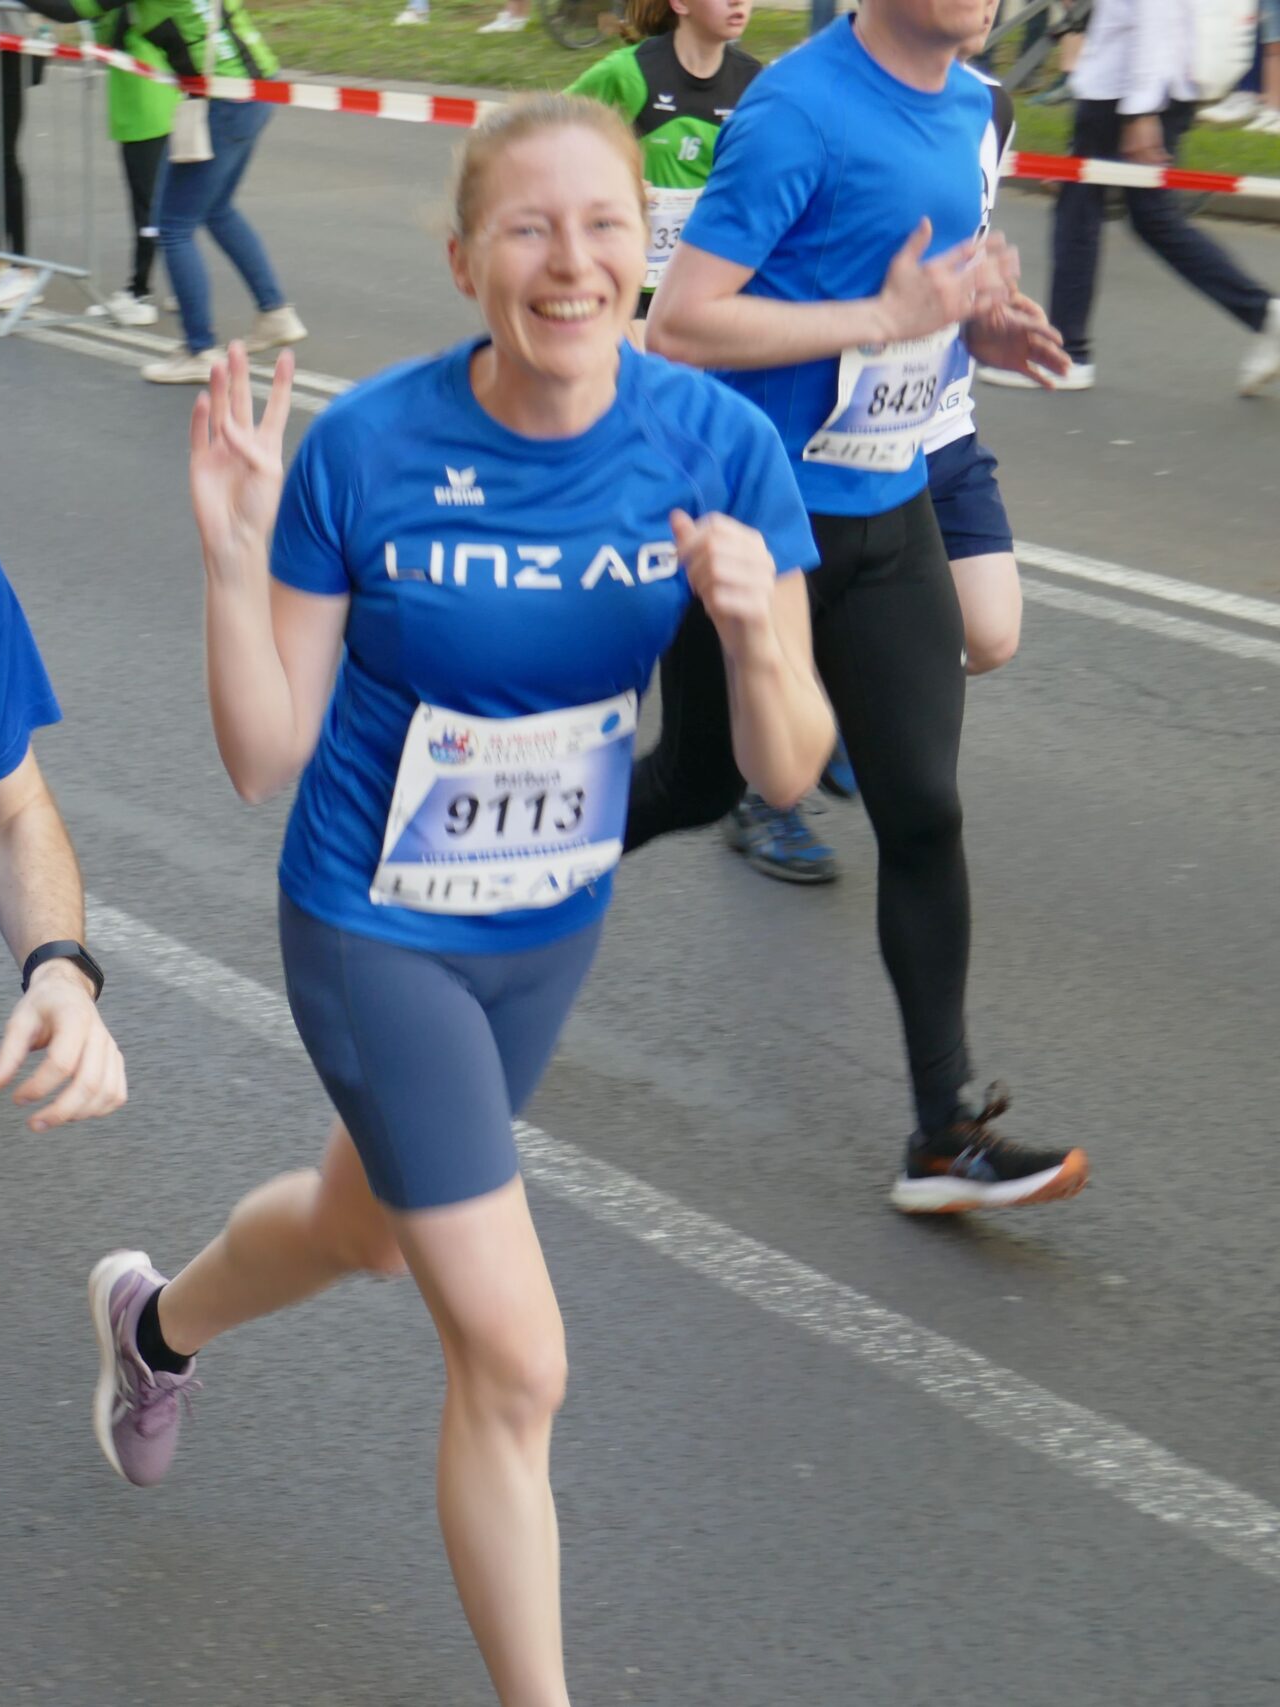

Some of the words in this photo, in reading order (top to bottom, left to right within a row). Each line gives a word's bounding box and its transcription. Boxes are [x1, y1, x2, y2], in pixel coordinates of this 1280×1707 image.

[677, 135, 702, 161] 16
[867, 374, 937, 417] 8428
[385, 541, 562, 590] LINZ
[444, 786, 586, 838] 9113
